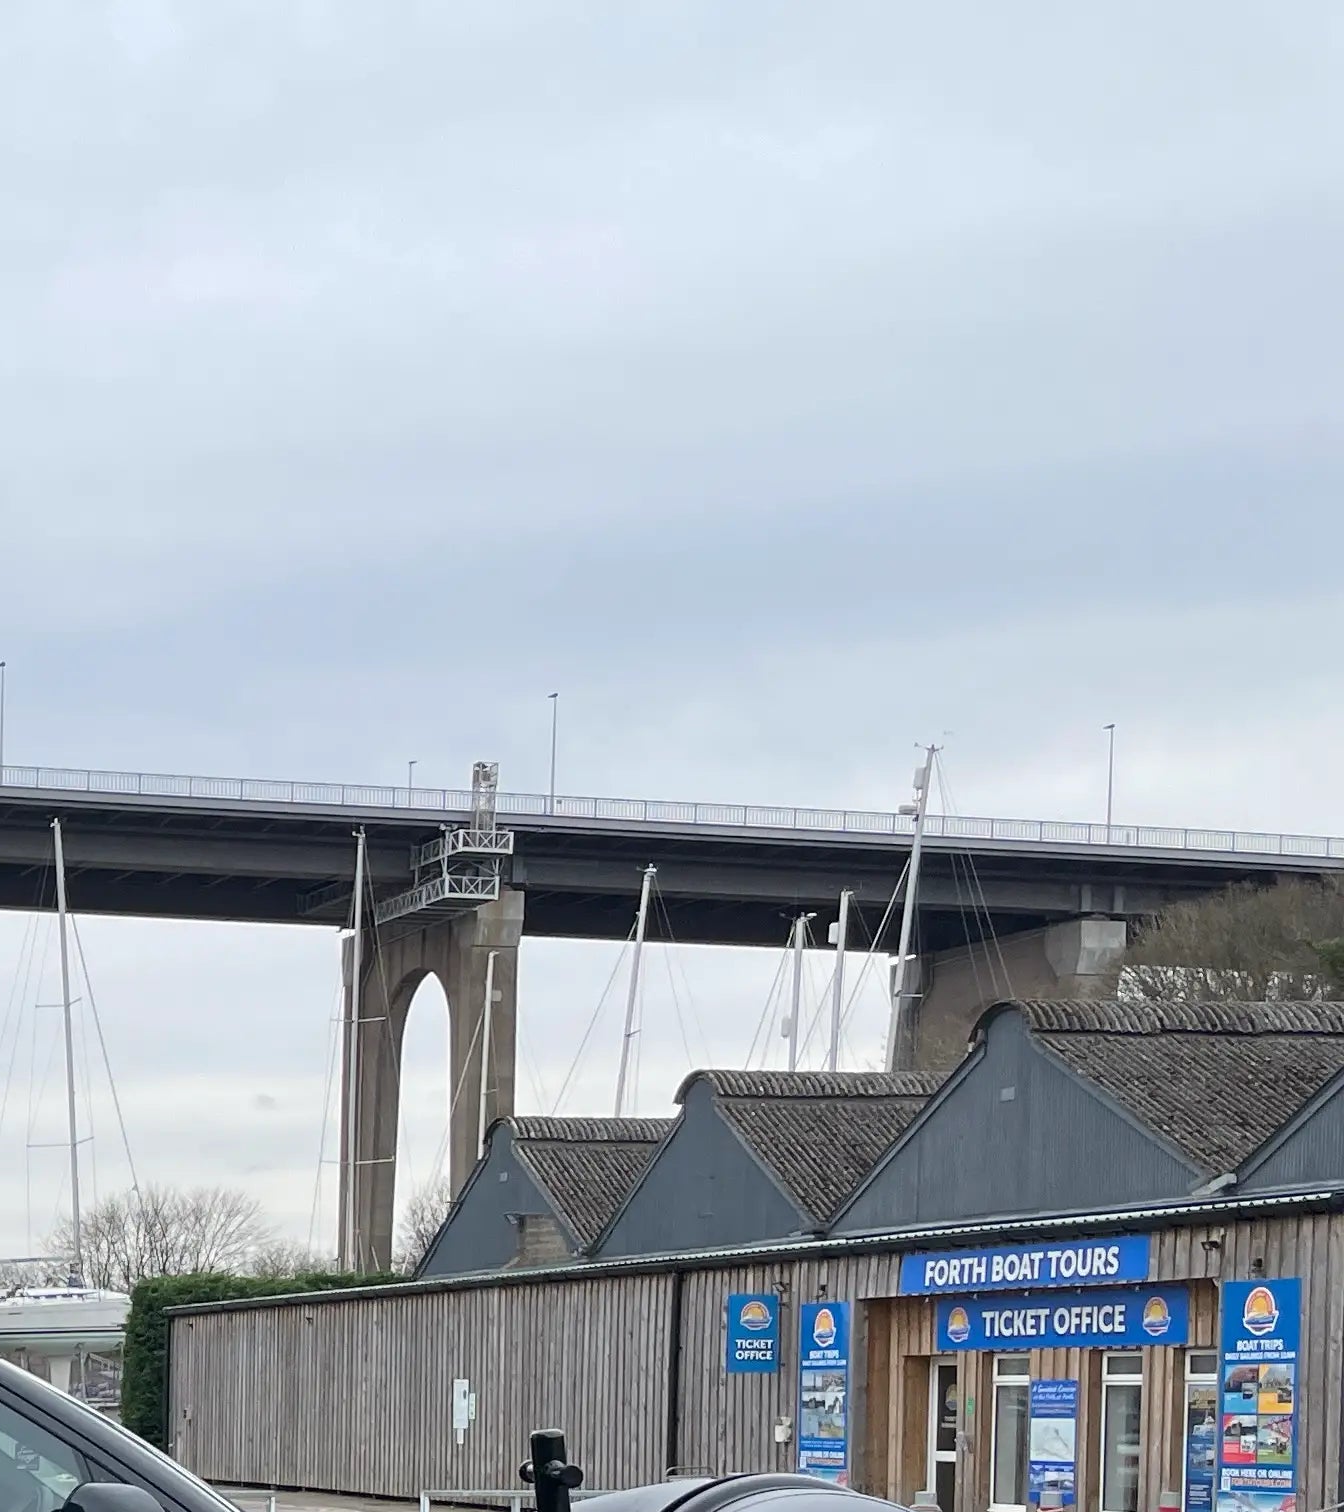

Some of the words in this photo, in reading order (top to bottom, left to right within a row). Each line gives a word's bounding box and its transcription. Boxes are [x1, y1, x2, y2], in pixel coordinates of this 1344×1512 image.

[924, 1257, 987, 1287] FORTH
[991, 1251, 1045, 1283] BOAT
[1047, 1246, 1120, 1278] TOURS
[982, 1308, 1050, 1338] TICKET
[1053, 1305, 1126, 1335] OFFICE
[735, 1339, 773, 1349] TICKET
[735, 1350, 773, 1360] OFFICE
